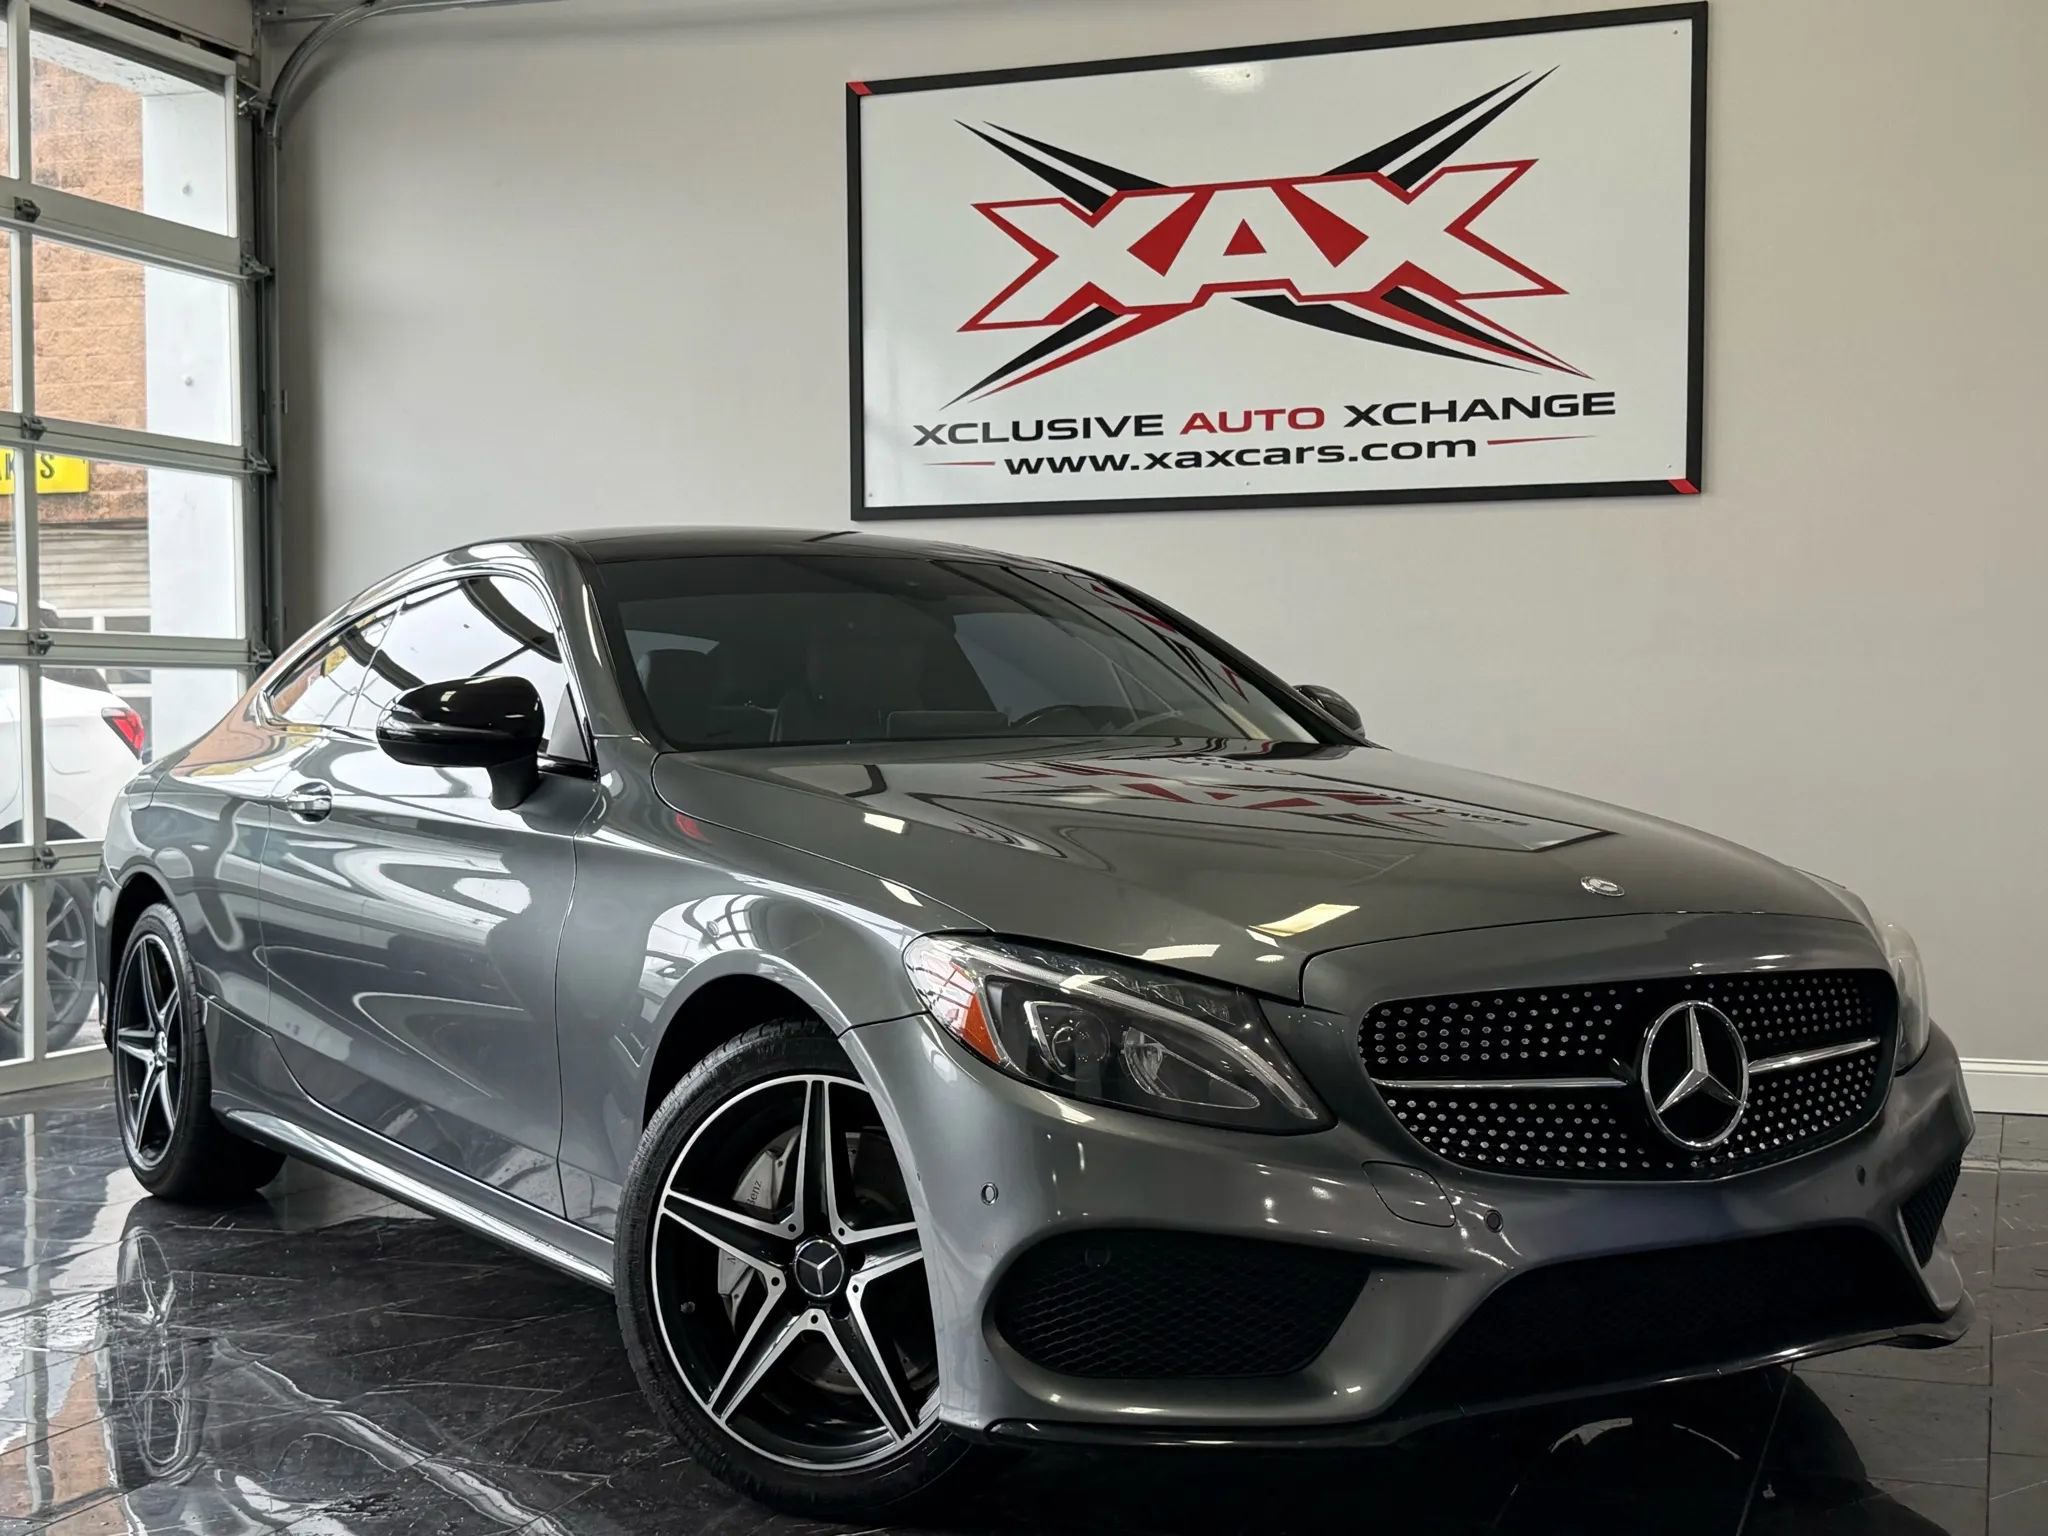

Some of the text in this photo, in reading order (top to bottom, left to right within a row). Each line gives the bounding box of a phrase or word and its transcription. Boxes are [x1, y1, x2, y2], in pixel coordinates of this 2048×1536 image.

[958, 159, 1569, 332] XAX
[913, 392, 1616, 447] XCLUSIVE AUTO XCHANGE
[1003, 438, 1477, 476] www.xaxcars.com
